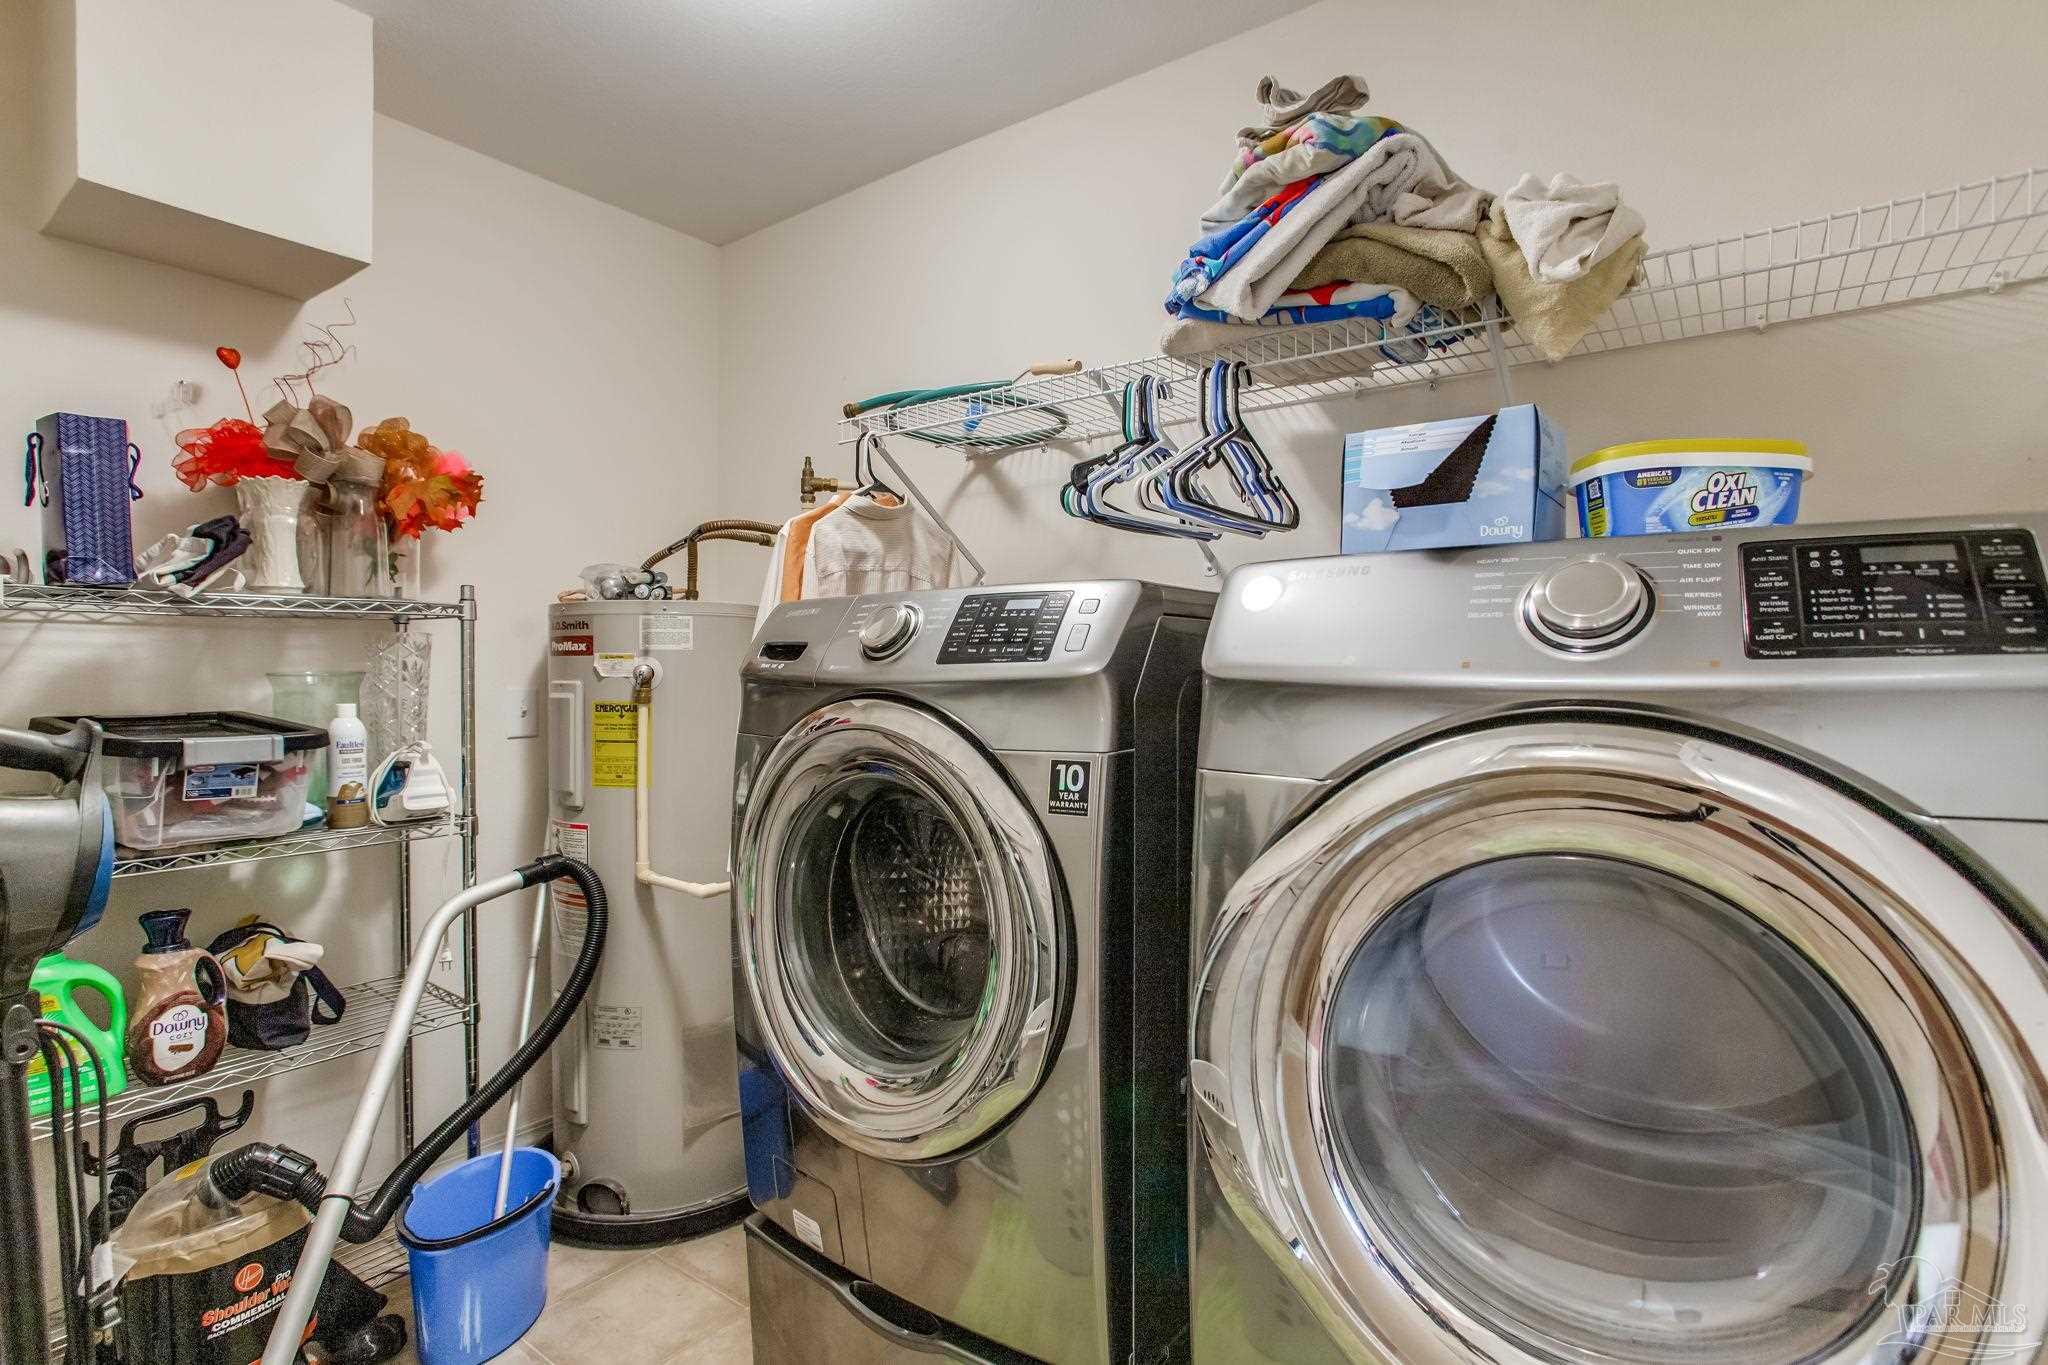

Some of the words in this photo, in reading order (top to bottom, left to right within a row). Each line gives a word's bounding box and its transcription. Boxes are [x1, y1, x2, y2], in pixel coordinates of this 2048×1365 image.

[1637, 470, 1672, 478] AMERICA'S
[1707, 472, 1746, 494] OXI
[1692, 486, 1757, 513] CLEAN
[1480, 525, 1523, 538] Downy
[1812, 631, 1829, 639] Dry
[551, 641, 587, 651] ProMax
[1055, 764, 1085, 792] 10
[1059, 791, 1080, 801] YEAR
[1049, 800, 1088, 809] WARRANTY
[153, 1015, 205, 1036] Downy
[169, 1031, 193, 1041] COZY
[275, 1269, 291, 1284] Pro
[200, 1287, 272, 1328] Shoulder
[211, 1292, 288, 1333] COMMERCIAL
